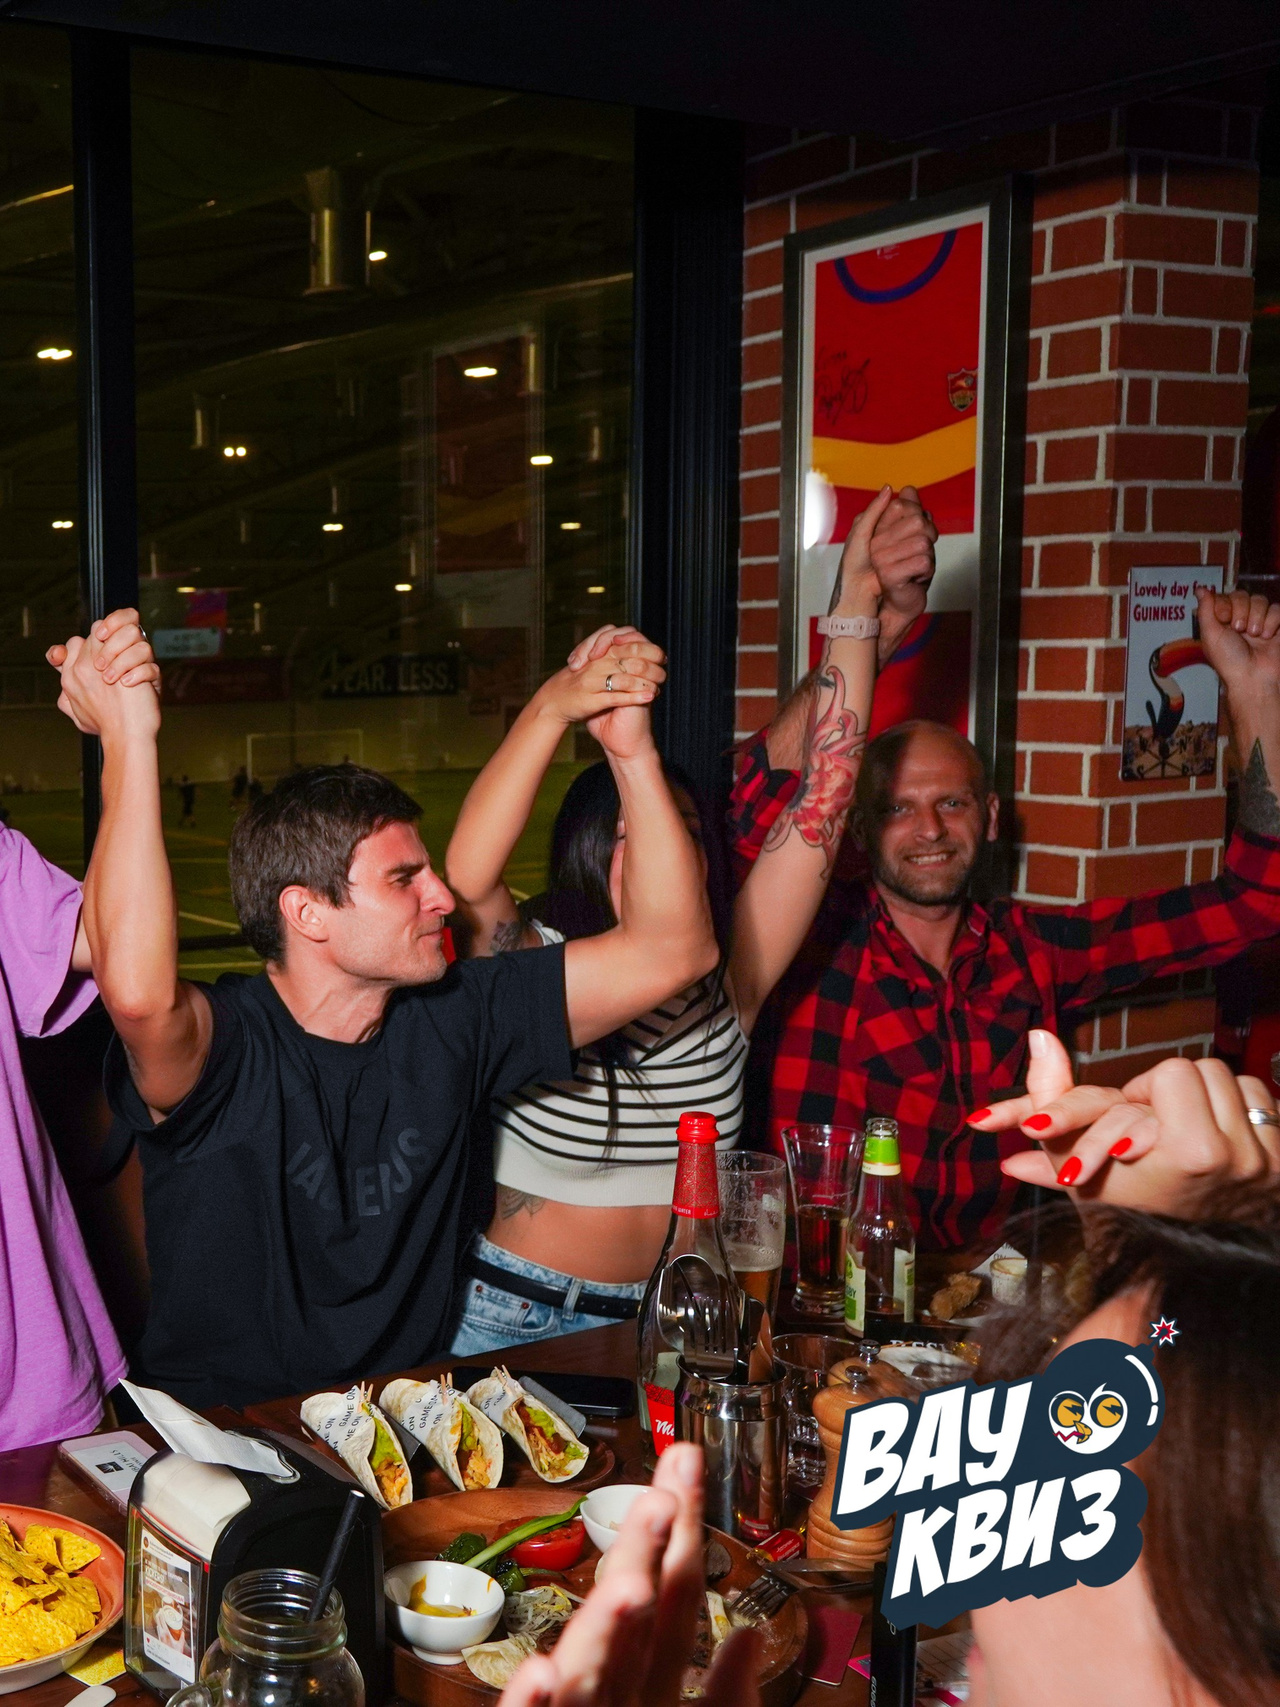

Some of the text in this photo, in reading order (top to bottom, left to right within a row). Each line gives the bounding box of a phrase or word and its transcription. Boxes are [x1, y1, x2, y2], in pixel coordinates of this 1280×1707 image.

[1135, 581, 1167, 599] Lovely
[1170, 580, 1189, 599] day
[1133, 604, 1185, 621] GUINNESS
[330, 662, 455, 692] EAR. LESS.
[339, 1388, 356, 1427] GAME ON
[324, 1418, 336, 1430] ON
[351, 1415, 363, 1427] ON
[408, 1415, 415, 1432] ON
